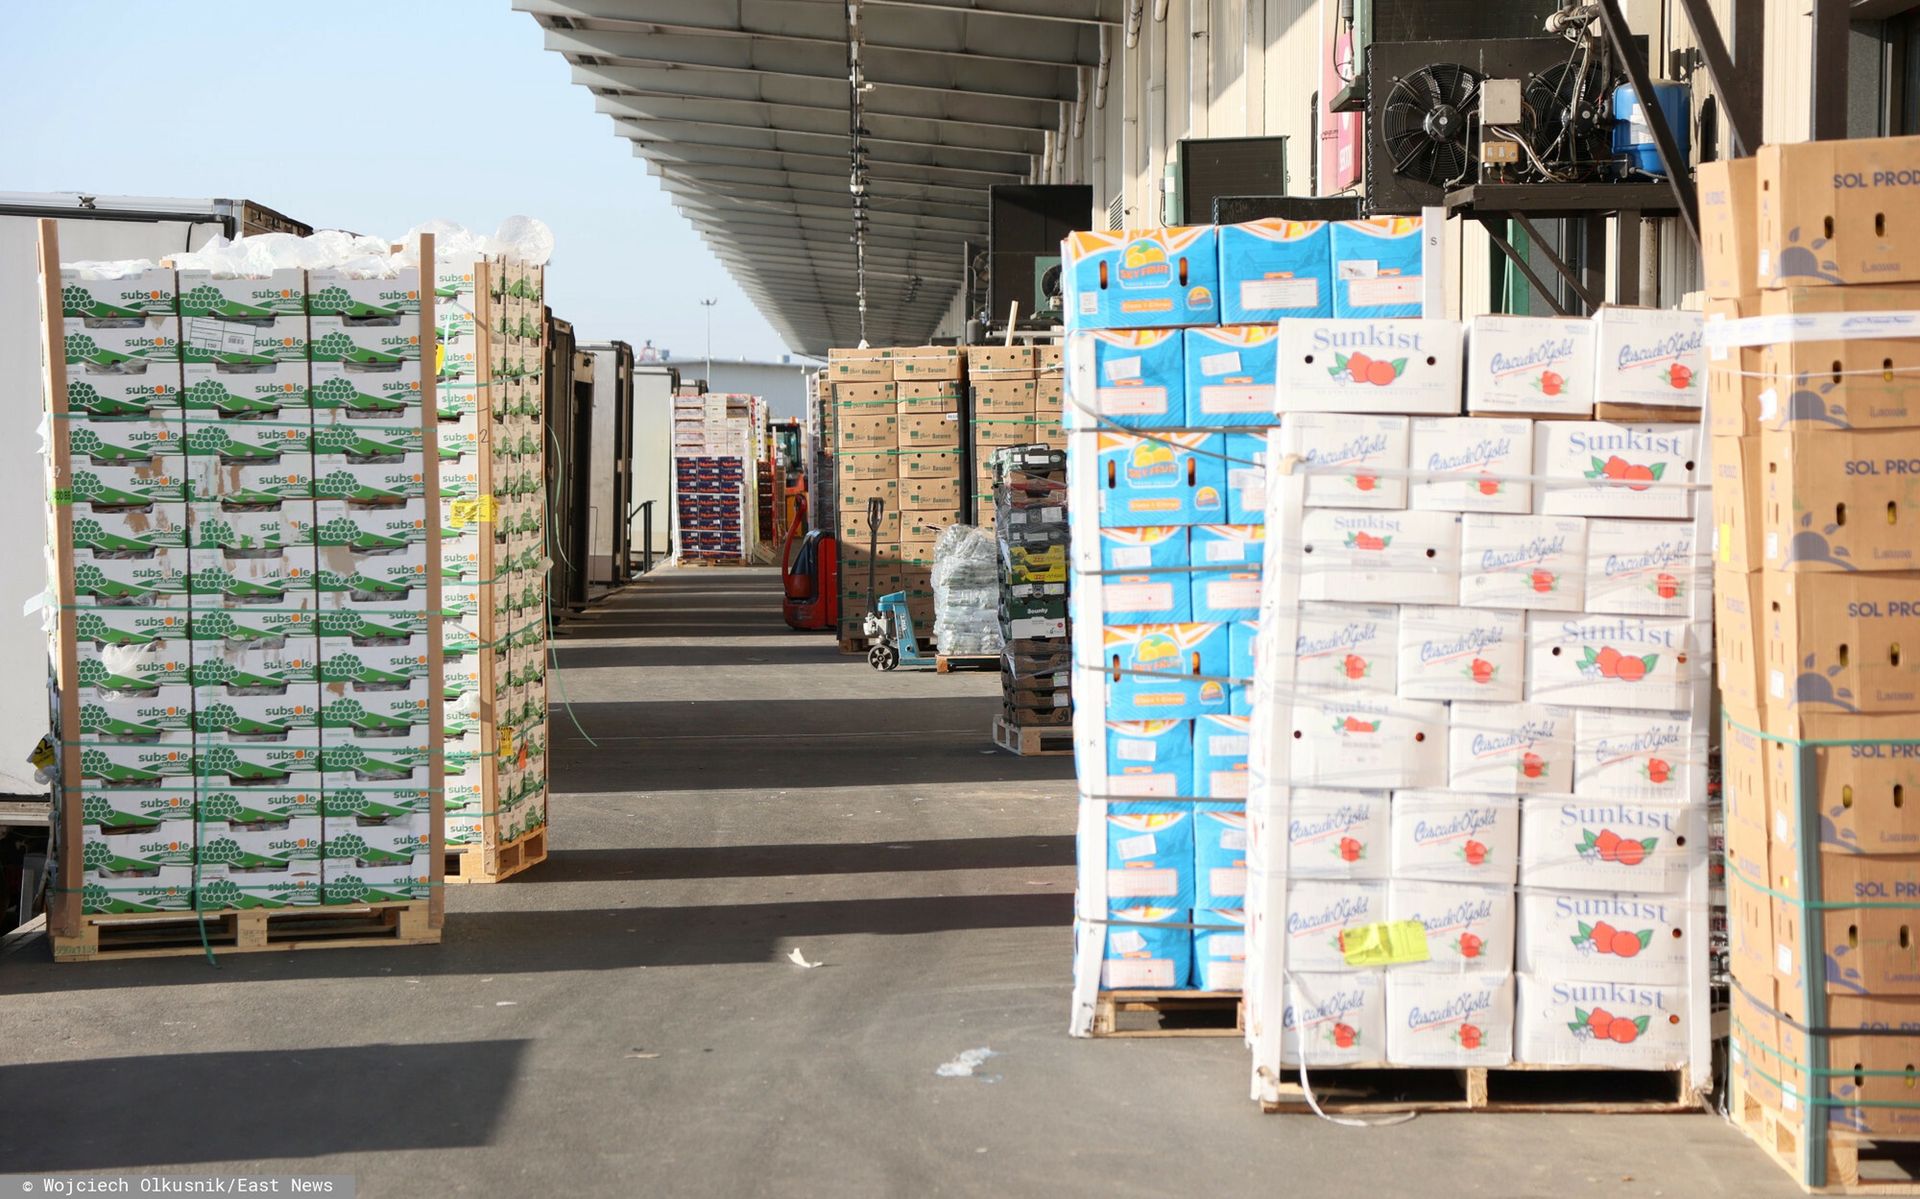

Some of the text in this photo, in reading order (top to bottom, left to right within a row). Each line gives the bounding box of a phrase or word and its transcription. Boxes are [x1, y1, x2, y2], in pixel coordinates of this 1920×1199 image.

[1833, 169, 1920, 189] SOL PROD
[1430, 237, 1438, 246] S
[120, 290, 171, 300] subsole
[252, 289, 301, 299] subsole
[379, 290, 419, 300] subsol
[125, 337, 175, 347] subsole
[254, 337, 303, 347] subsole
[381, 336, 421, 345] subsol
[1312, 324, 1423, 353] Sunkist
[125, 385, 176, 395] subsole
[255, 383, 304, 393] subsole
[382, 381, 422, 391] subsol
[128, 431, 178, 441] subsole
[257, 429, 307, 439] subsole
[1568, 430, 1682, 457] Sunkist
[1845, 459, 1880, 476] SOL
[258, 474, 308, 485] subsole
[384, 473, 425, 483] subsol
[386, 519, 426, 530] subsol
[1334, 516, 1403, 533] Sunkist
[132, 568, 183, 578] subsle
[387, 564, 427, 575] subsol
[1848, 602, 1883, 618] SOL
[134, 617, 185, 626] subsole
[262, 614, 311, 623] subsole
[1562, 620, 1674, 646] Sunkist
[136, 662, 185, 672] subsole
[390, 699, 429, 710] subsol
[137, 707, 187, 716] subsole
[265, 705, 314, 715] subsole
[266, 750, 315, 760] subsole
[1851, 744, 1886, 758] SOL
[138, 752, 188, 762] subsole
[140, 797, 190, 808] subsole
[267, 794, 316, 804] subsole
[1560, 804, 1673, 832] Sunkist
[139, 842, 189, 852] subsole
[269, 838, 317, 849] subsole
[1855, 882, 1888, 897] SOL
[1556, 896, 1670, 924] Sunkist
[1552, 983, 1666, 1010] Sunkist
